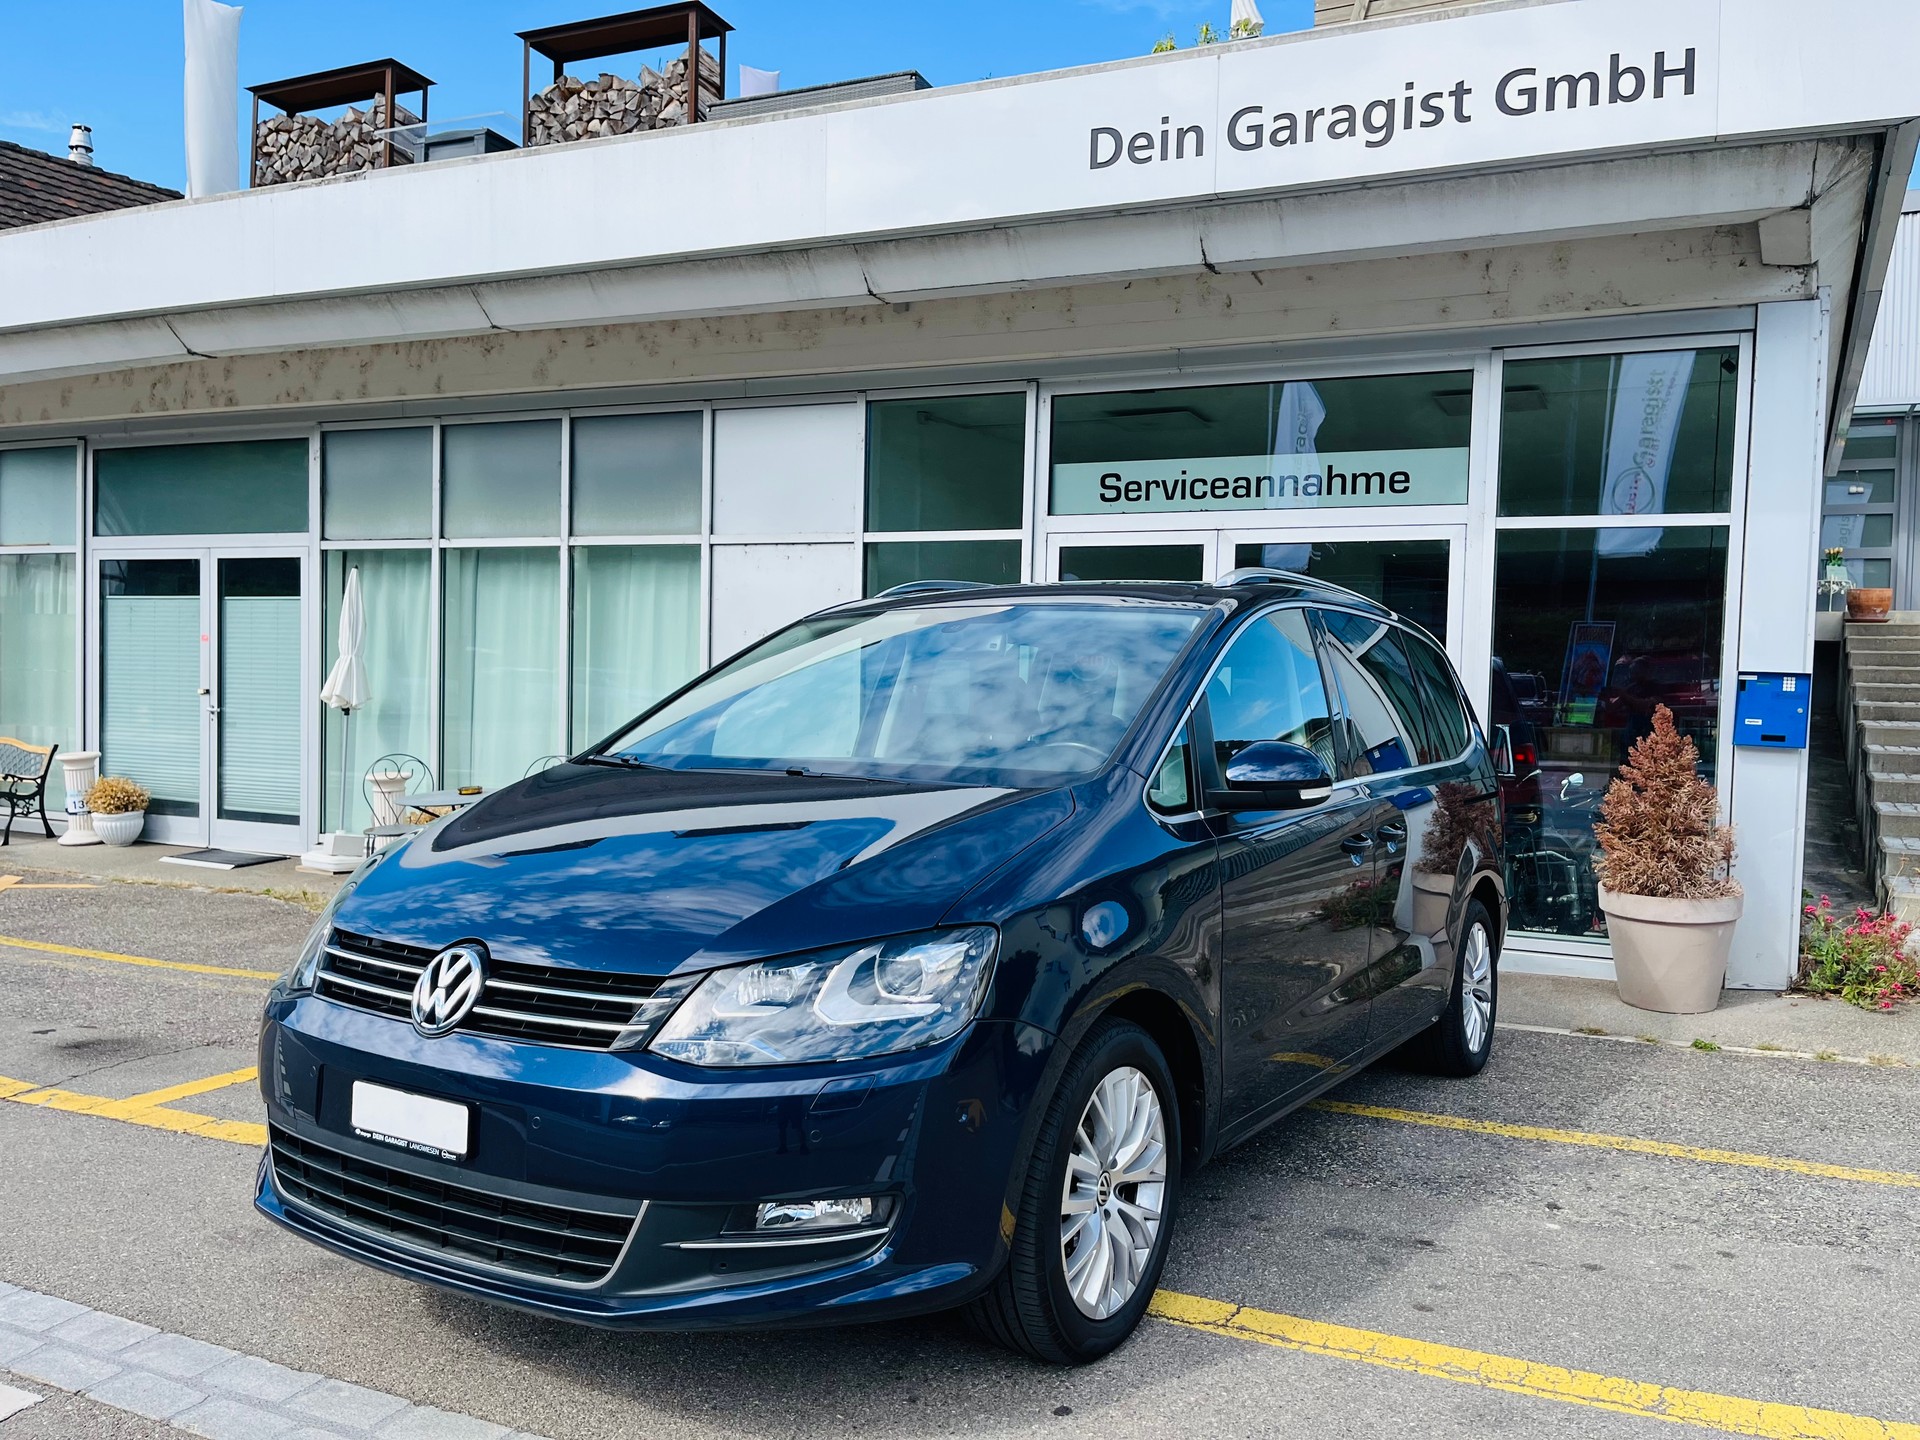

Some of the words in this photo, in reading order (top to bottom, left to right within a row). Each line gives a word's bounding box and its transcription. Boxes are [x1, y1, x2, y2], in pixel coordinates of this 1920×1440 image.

[1090, 116, 1204, 170] Dein
[1227, 82, 1473, 149] Garagist
[1495, 48, 1696, 116] GmbH
[1099, 464, 1411, 502] Serviceannahme
